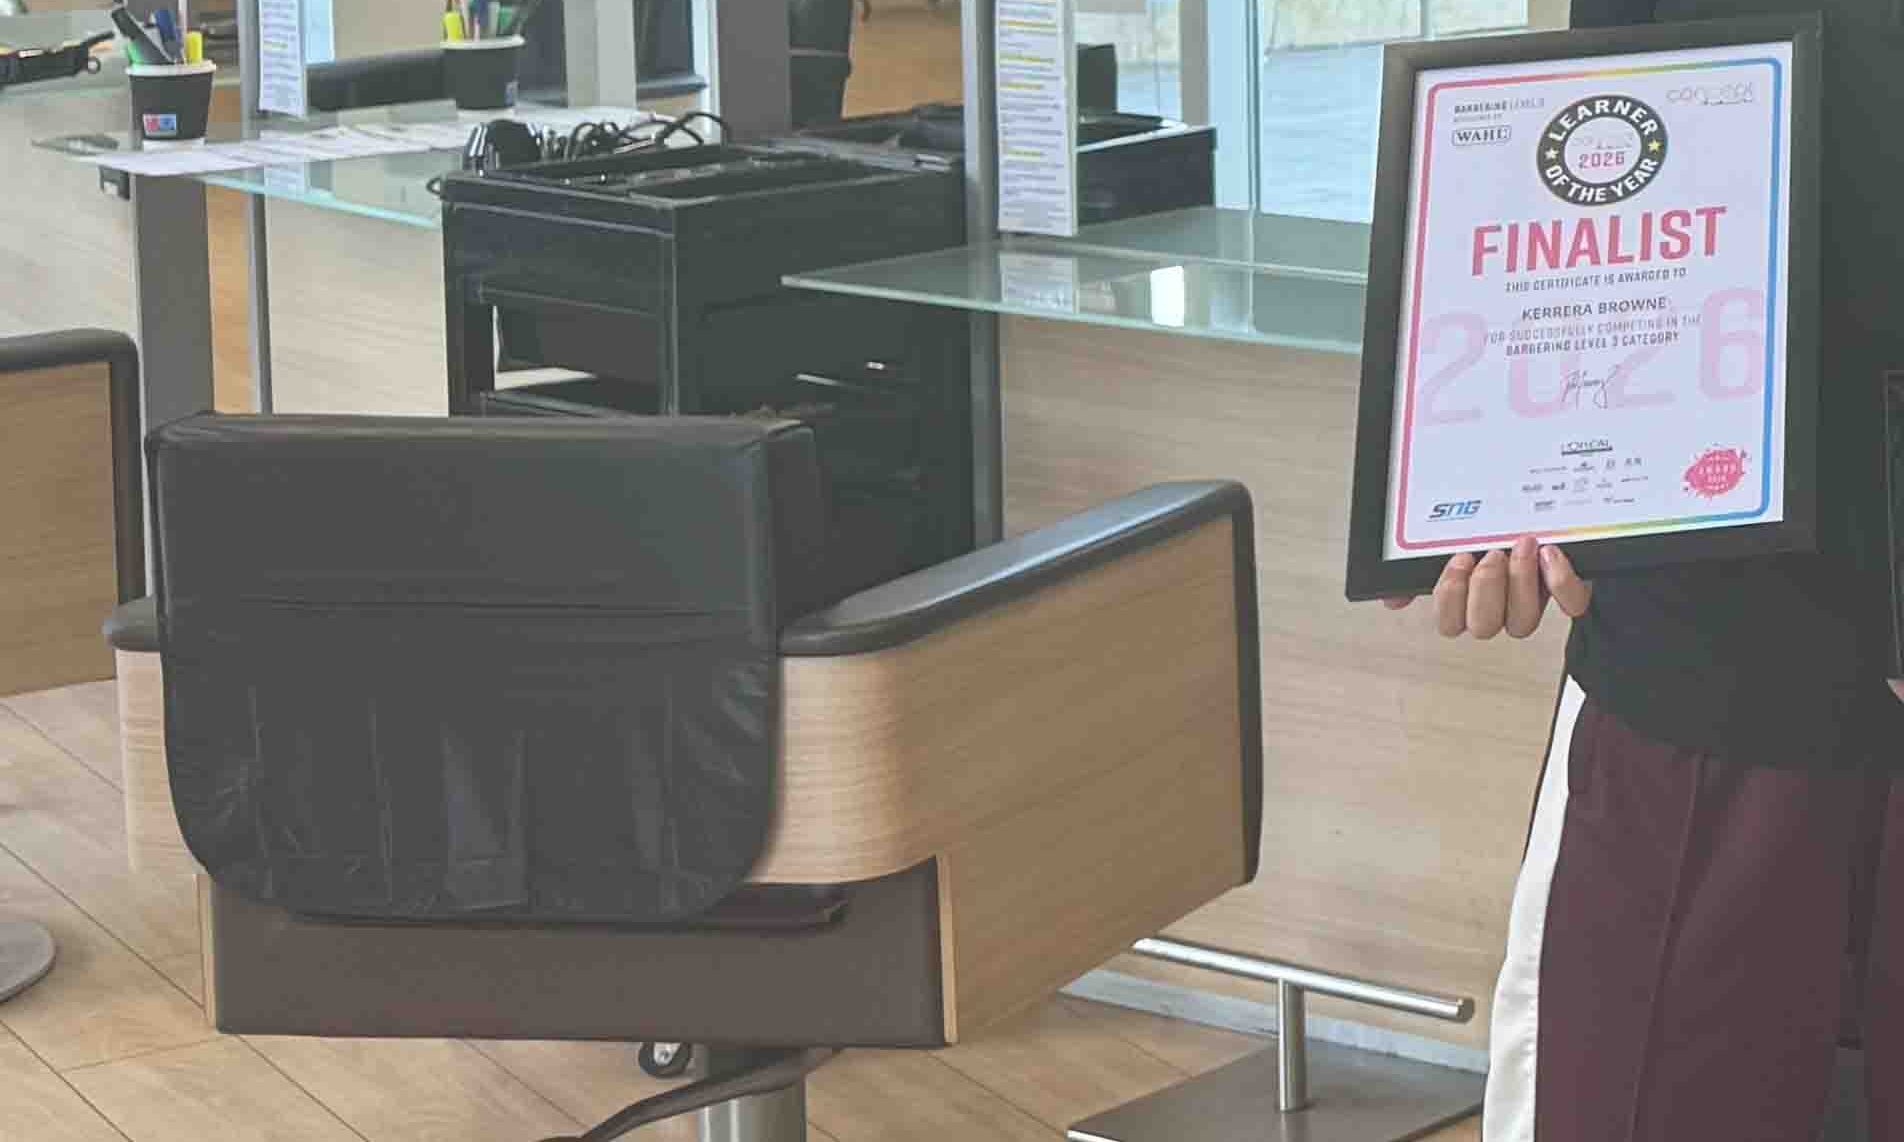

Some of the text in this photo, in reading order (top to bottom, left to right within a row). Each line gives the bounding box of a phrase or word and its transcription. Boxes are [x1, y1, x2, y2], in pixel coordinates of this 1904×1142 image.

[1548, 98, 1660, 143] LEARNER
[1578, 150, 1625, 170] 2026
[1545, 157, 1659, 202] OF THE YEAR
[1471, 205, 1728, 277] FINALIST
[1533, 275, 1601, 292] CERTIFICATE
[1617, 268, 1671, 284] AWARDED
[1521, 296, 1667, 322] KERRERA BROWNE
[1621, 330, 1680, 348] CATEGORY
